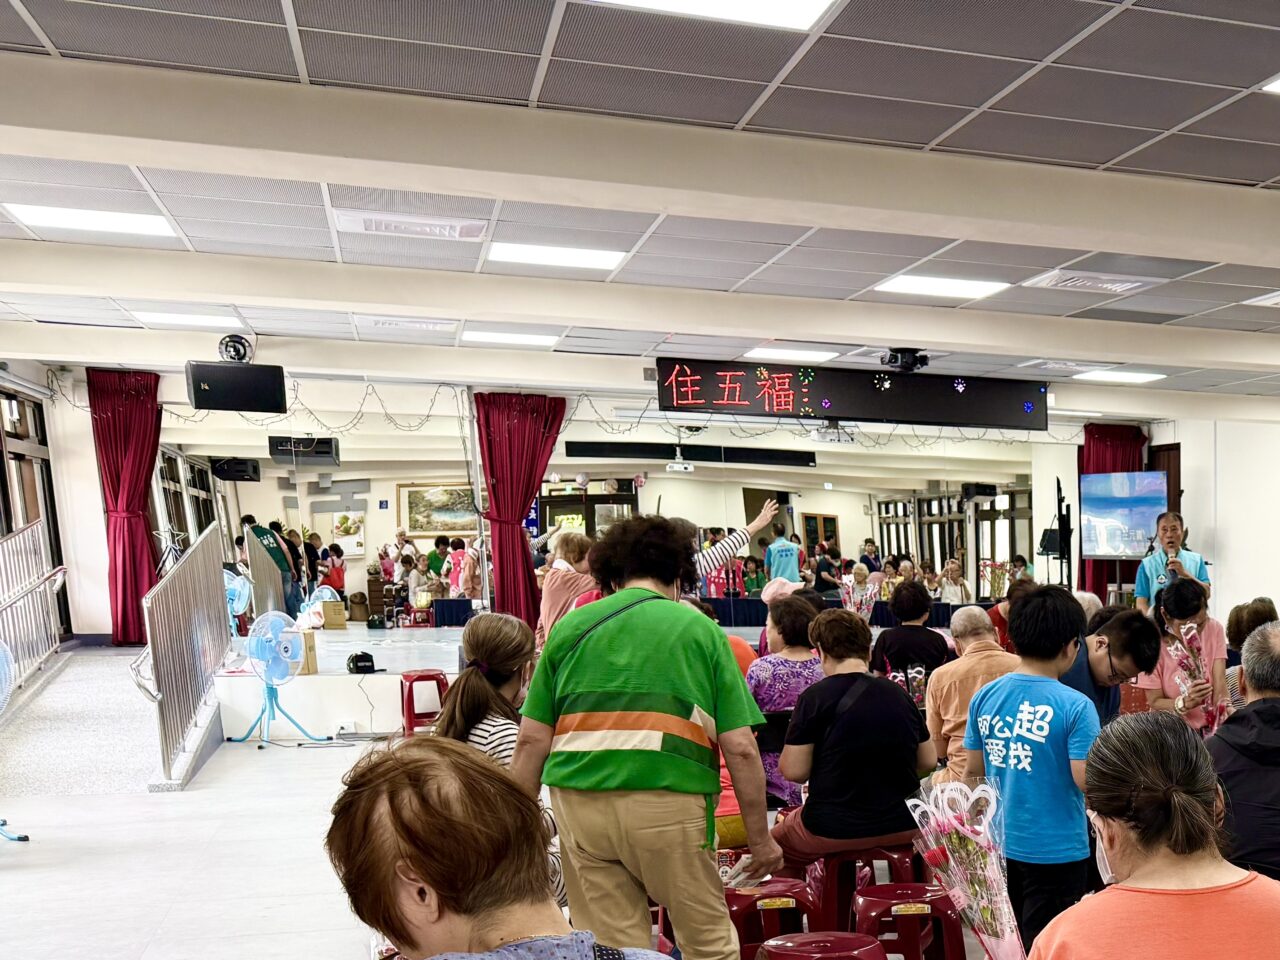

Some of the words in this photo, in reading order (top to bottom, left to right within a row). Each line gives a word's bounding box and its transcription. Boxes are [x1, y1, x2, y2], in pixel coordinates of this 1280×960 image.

[665, 364, 808, 411] 住五福
[984, 739, 1033, 772] 愛我
